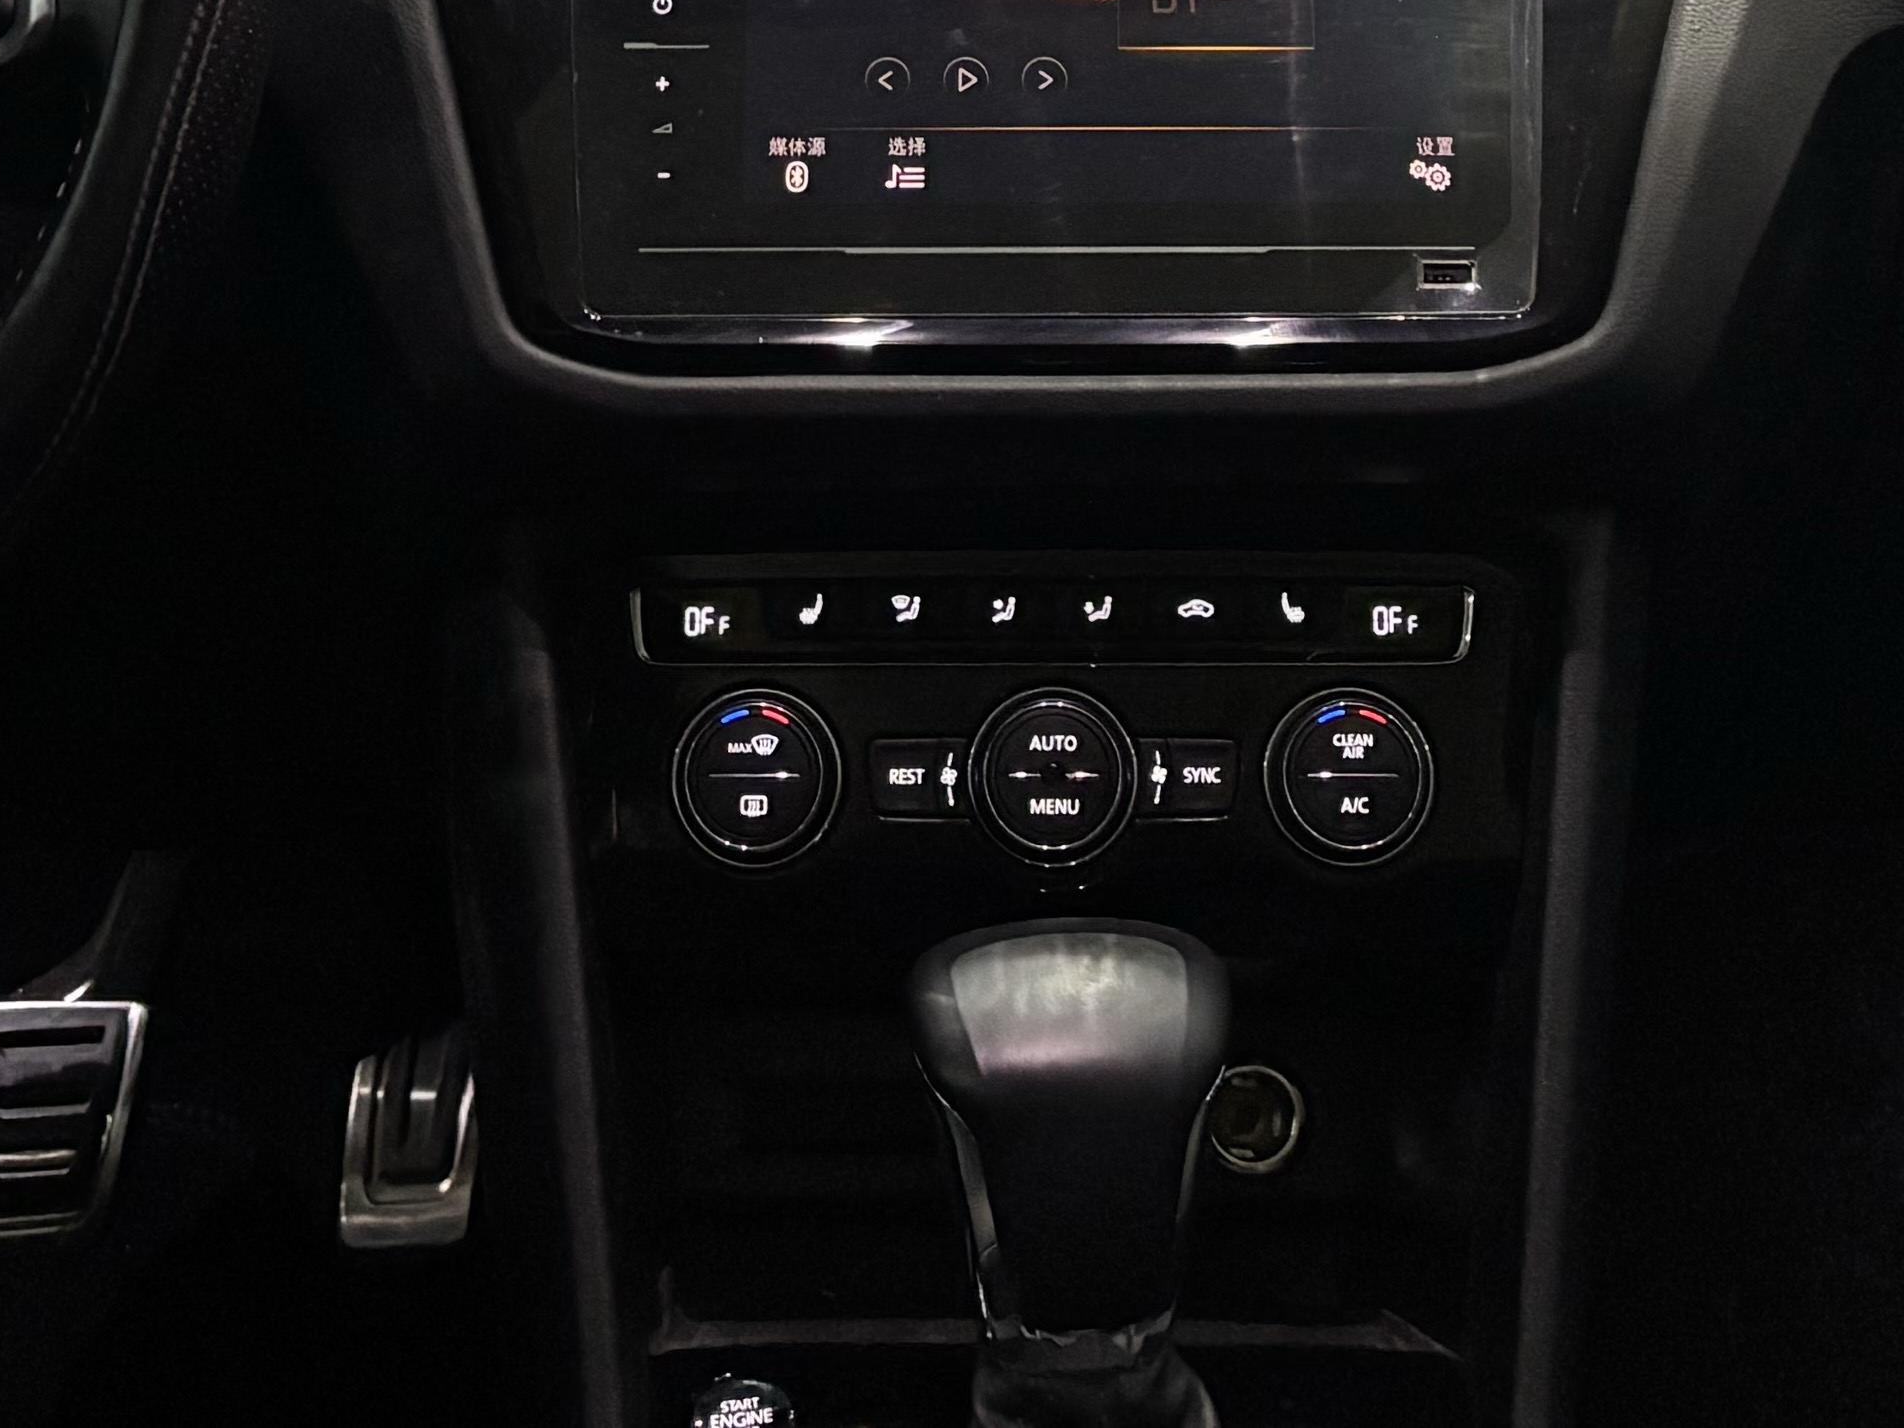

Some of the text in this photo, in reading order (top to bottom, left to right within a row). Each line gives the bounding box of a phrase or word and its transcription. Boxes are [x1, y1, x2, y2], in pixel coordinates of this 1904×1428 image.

[768, 136, 827, 157] 媒体源
[887, 136, 926, 157] 选择
[1415, 136, 1455, 157] 设置
[727, 739, 752, 753] MAX
[1028, 734, 1079, 752] AUTO
[1332, 732, 1374, 747] CLEAN
[1342, 746, 1366, 760] AIR
[888, 767, 926, 785] REST
[1182, 766, 1222, 784] SYNC
[1029, 797, 1081, 816] MENU
[1340, 796, 1371, 815] A/C
[720, 1396, 761, 1413] START
[709, 1407, 774, 1428] ENGINE
